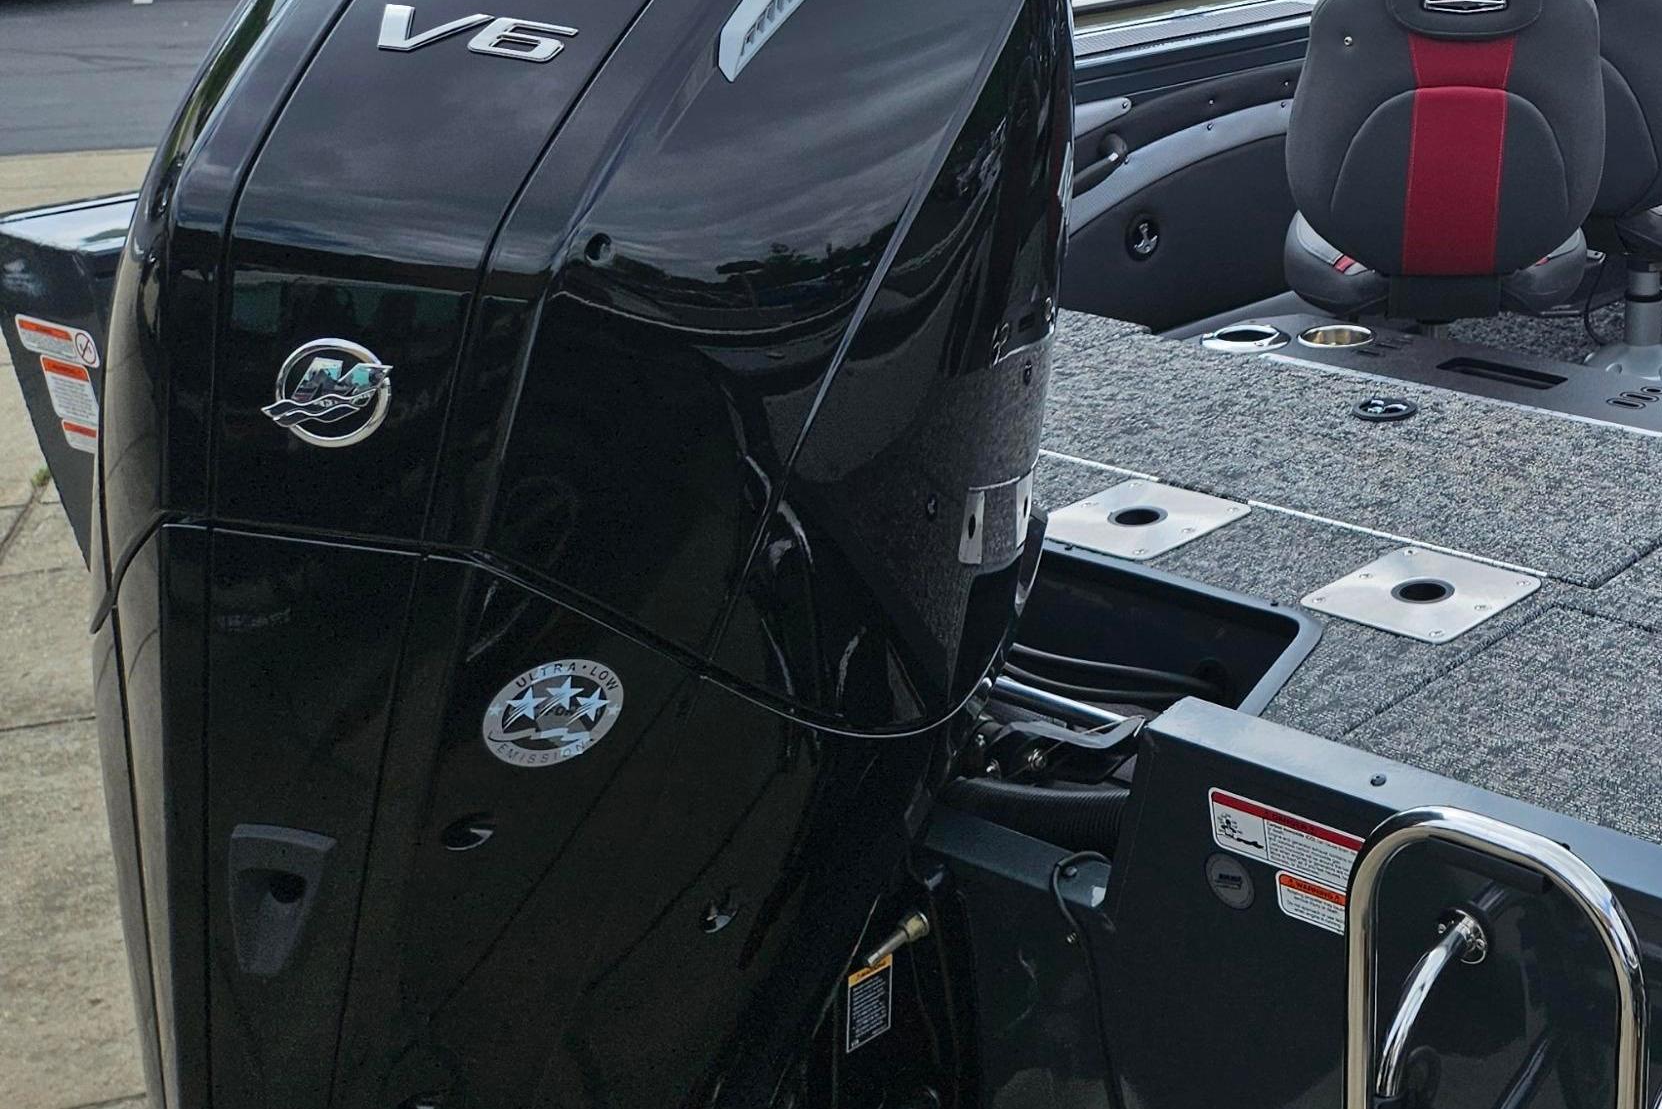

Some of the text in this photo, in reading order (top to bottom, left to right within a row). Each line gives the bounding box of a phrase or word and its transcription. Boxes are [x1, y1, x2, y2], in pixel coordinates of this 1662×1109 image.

[377, 3, 579, 63] V6
[516, 662, 619, 691] ULTRA LOW
